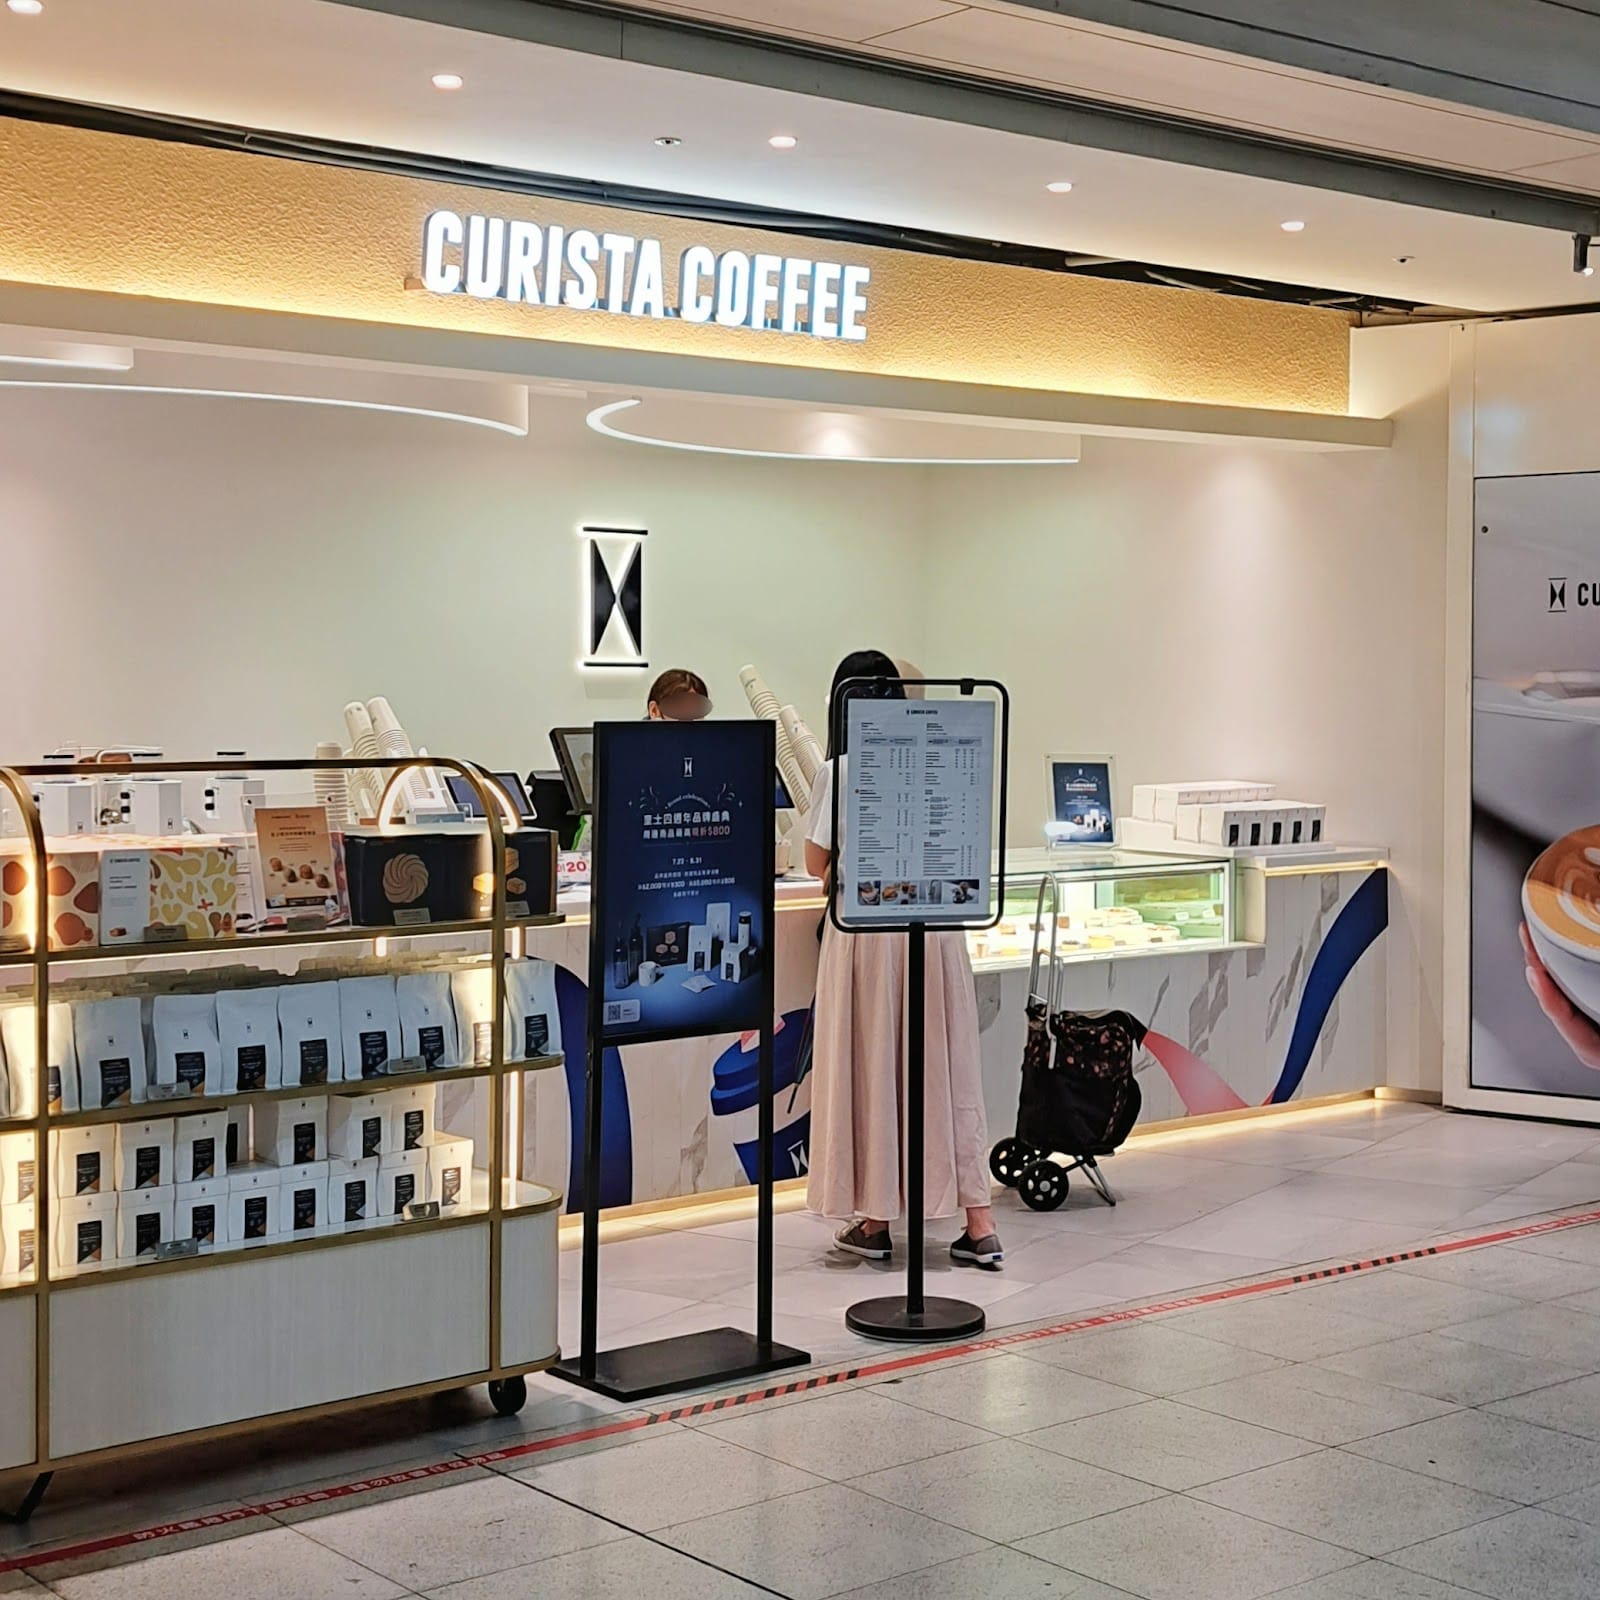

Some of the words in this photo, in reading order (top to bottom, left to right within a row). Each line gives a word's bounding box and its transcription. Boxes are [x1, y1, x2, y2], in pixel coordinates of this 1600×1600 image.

[422, 209, 665, 320] CURISTA
[679, 245, 871, 342] COFFEE
[1577, 582, 1600, 607] CU
